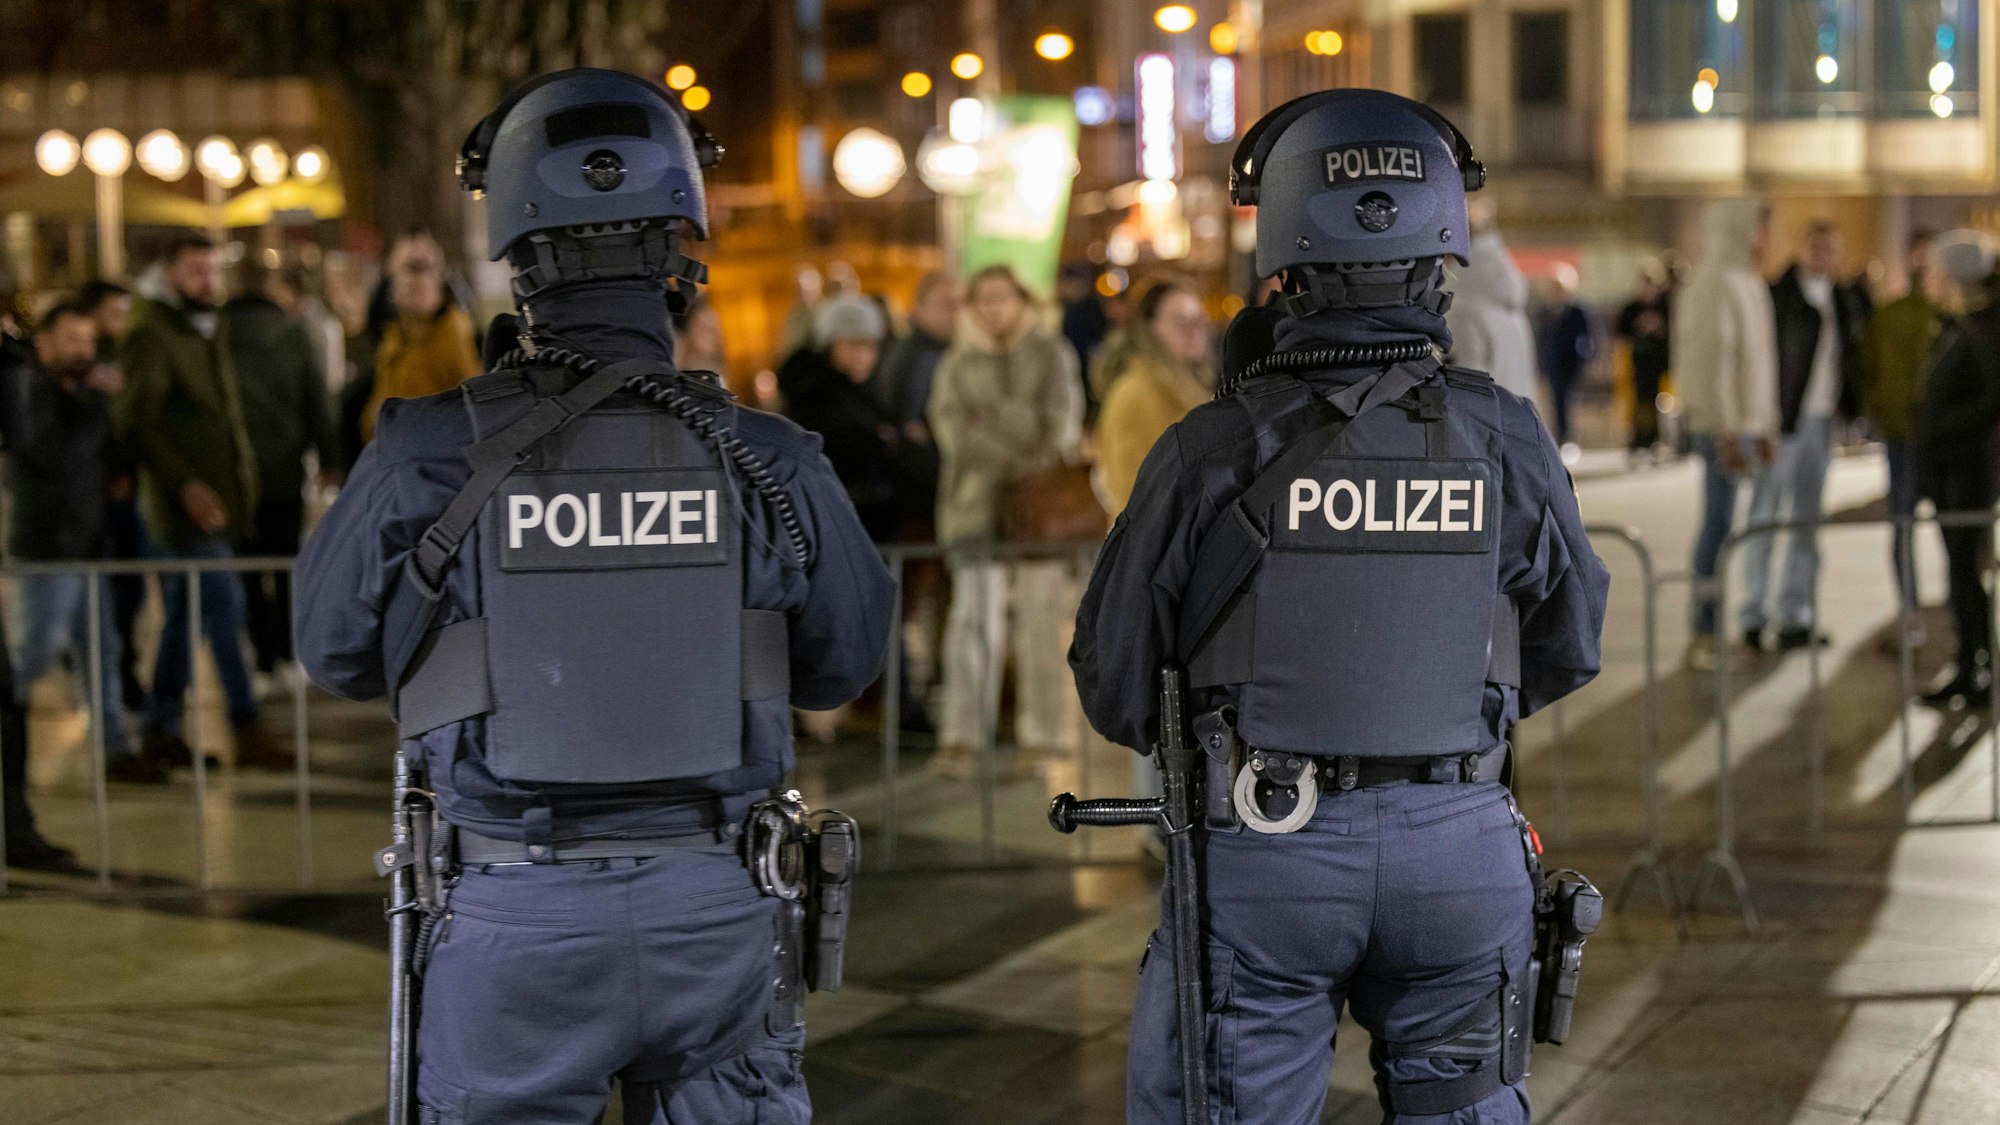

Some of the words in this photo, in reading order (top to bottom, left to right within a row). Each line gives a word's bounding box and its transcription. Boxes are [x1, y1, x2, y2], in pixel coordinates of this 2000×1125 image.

[1326, 147, 1423, 182] POLIZEI
[508, 489, 718, 549] POLIZEI
[1288, 478, 1484, 532] POLIZEI
